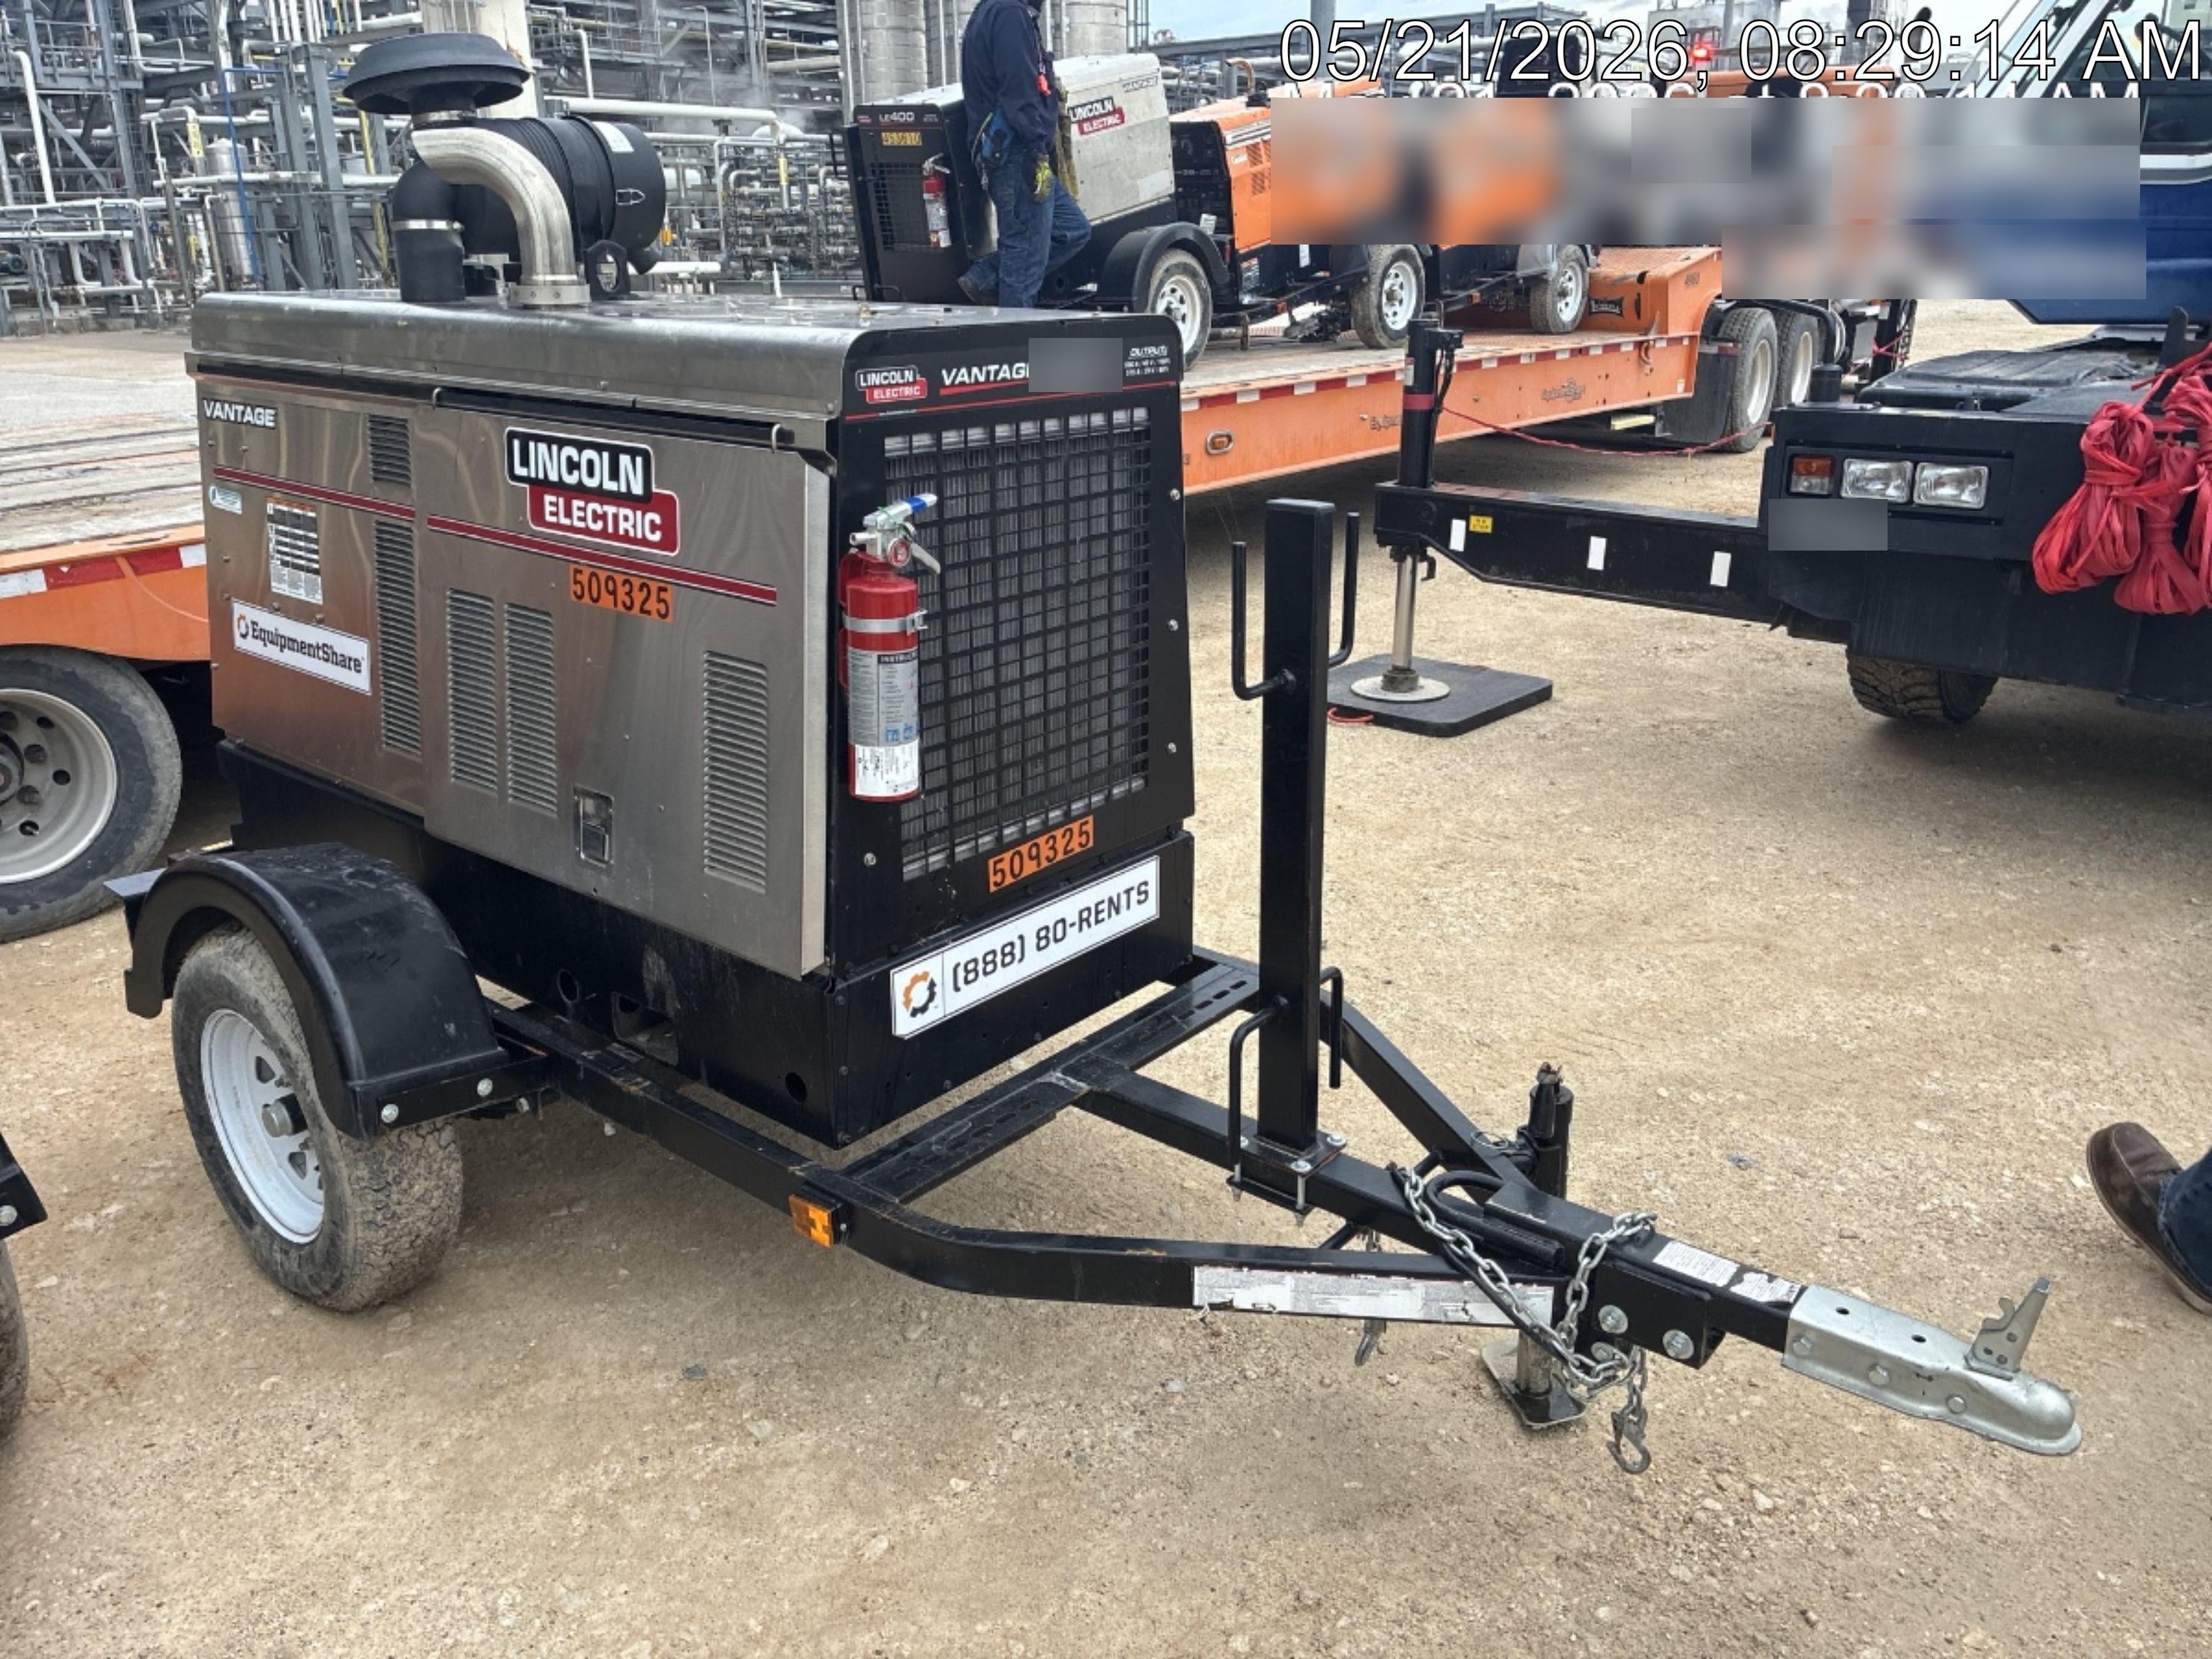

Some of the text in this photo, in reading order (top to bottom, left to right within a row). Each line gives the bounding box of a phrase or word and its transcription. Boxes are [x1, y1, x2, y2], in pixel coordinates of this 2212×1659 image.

[1069, 98, 1113, 122] LINCOLN
[1083, 114, 1121, 132] ELECTRIC
[860, 369, 914, 386] LINCOLN
[873, 385, 920, 399] ELECTRIC
[941, 362, 1029, 386] VANTAG
[202, 399, 276, 428] VANTAGE
[512, 438, 644, 495] LINCOLN
[543, 493, 662, 543] ELECTRIC
[573, 567, 670, 619] 509325
[250, 620, 363, 673] EquipmentShare
[992, 818, 1091, 888] 509325
[952, 880, 1150, 992] (888) 80-RENTS
